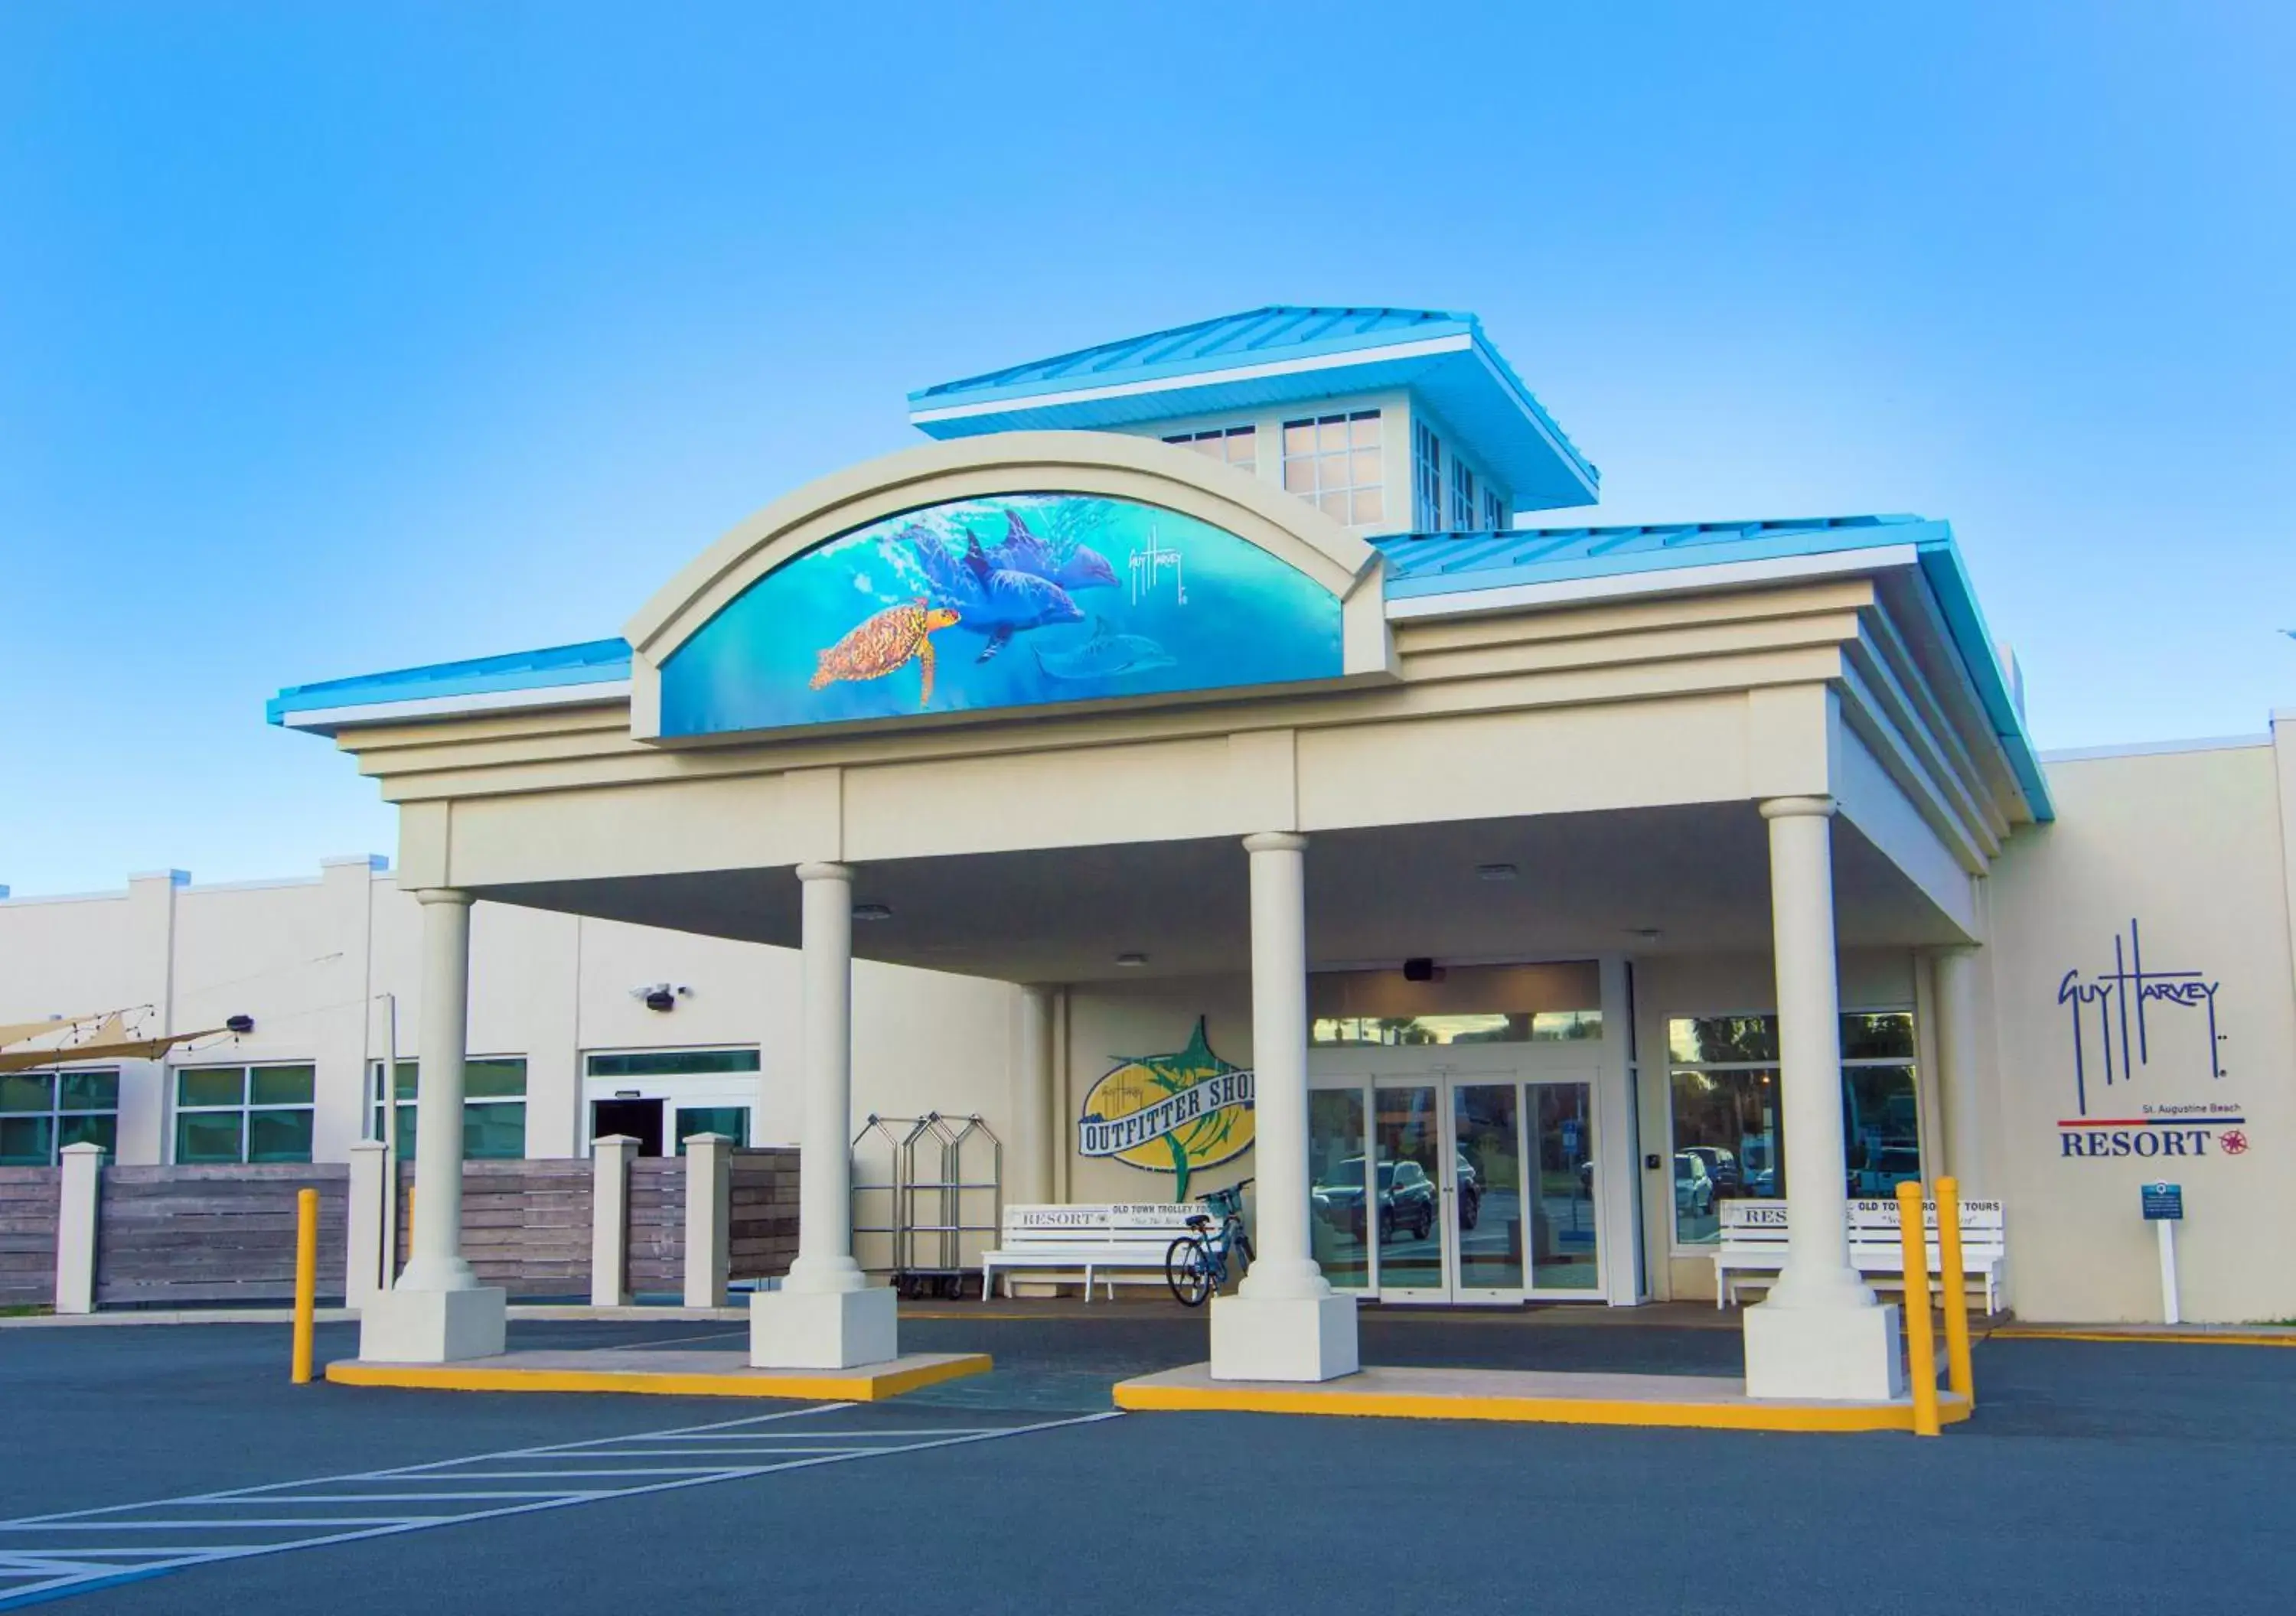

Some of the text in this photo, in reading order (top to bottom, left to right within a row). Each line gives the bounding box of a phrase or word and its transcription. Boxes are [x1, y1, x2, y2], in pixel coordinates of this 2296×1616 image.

[2098, 918, 2219, 1079] HARVEY
[2142, 1103, 2241, 1114] St. Augustine Beach
[1086, 1089, 1201, 1151] OUTFITTER
[2060, 1130, 2211, 1158] RESORT
[1113, 1205, 1129, 1214] OLD
[1131, 1205, 1155, 1214] TOWN
[1158, 1205, 1192, 1214] TROLLEY
[1857, 1202, 1878, 1211] OLD
[1965, 1202, 2000, 1211] TOURS
[1023, 1212, 1093, 1225] RESORT
[1746, 1210, 1787, 1223] RES
